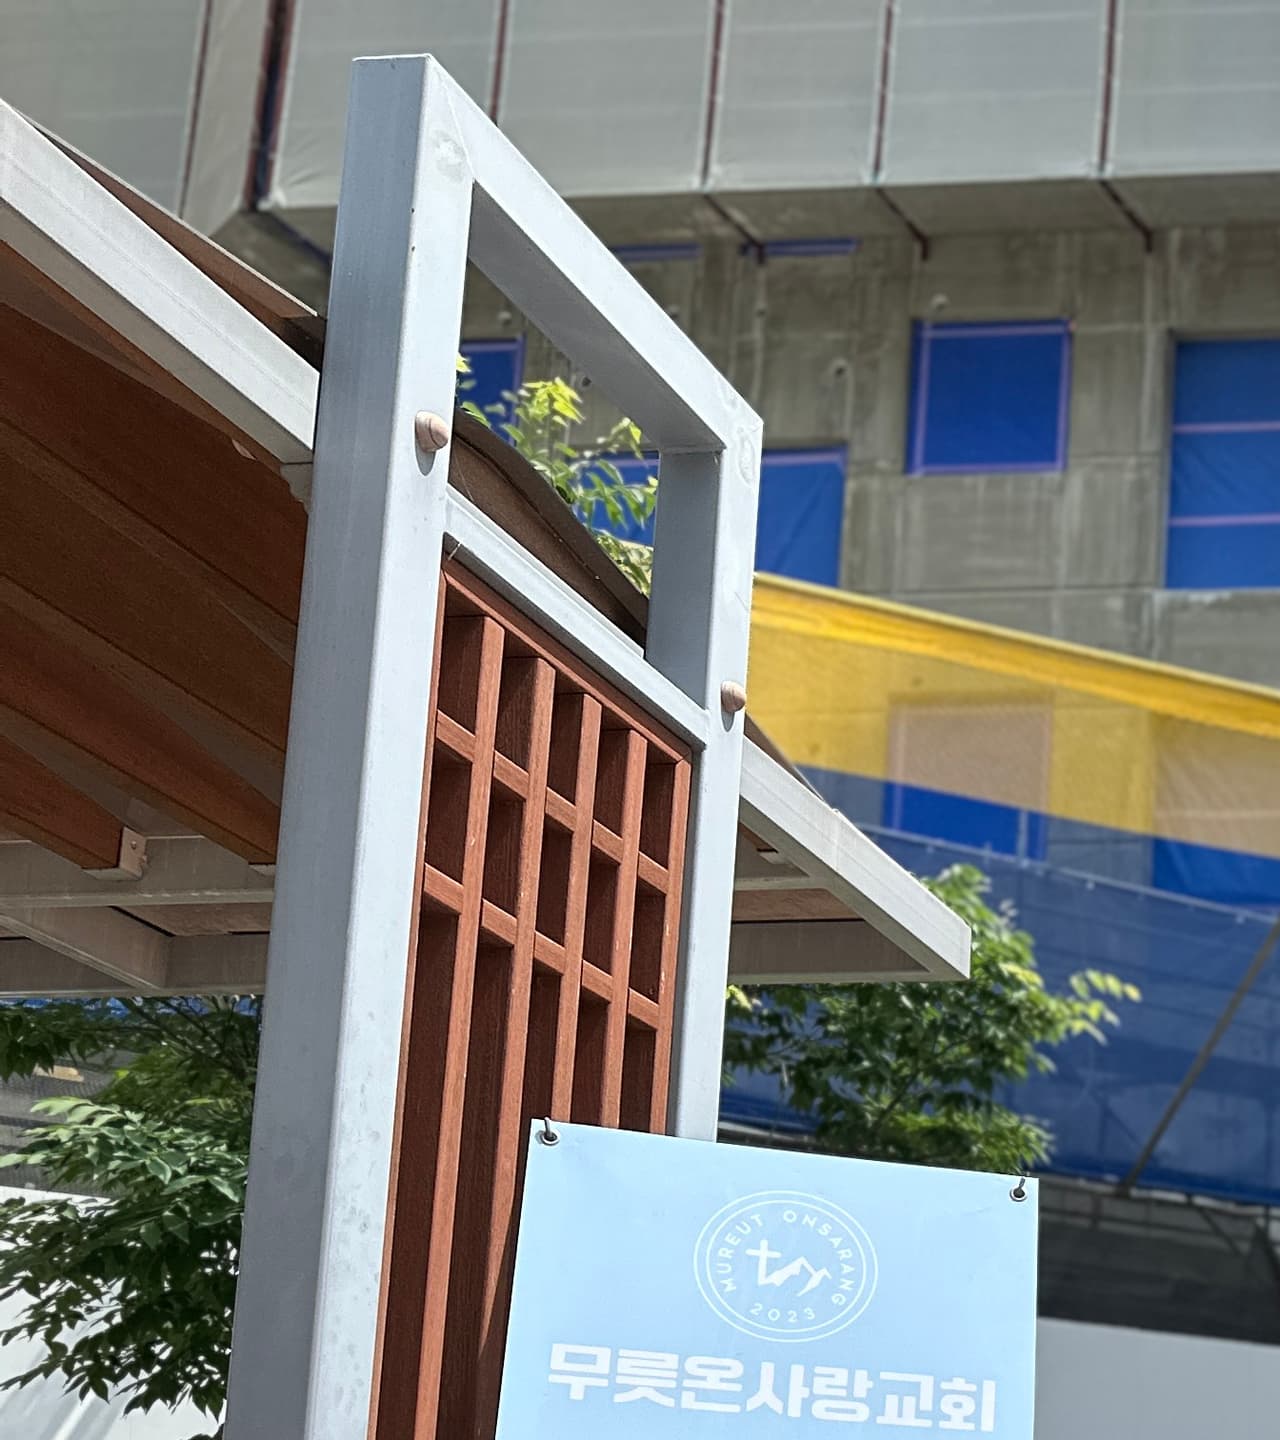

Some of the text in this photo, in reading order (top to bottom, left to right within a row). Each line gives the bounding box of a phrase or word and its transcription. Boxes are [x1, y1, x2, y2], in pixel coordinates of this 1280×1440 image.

[717, 1210, 855, 1306] MUREUT ONSARANG
[750, 1302, 815, 1323] 2023
[548, 1343, 996, 1432] 무릇온사랑교회
